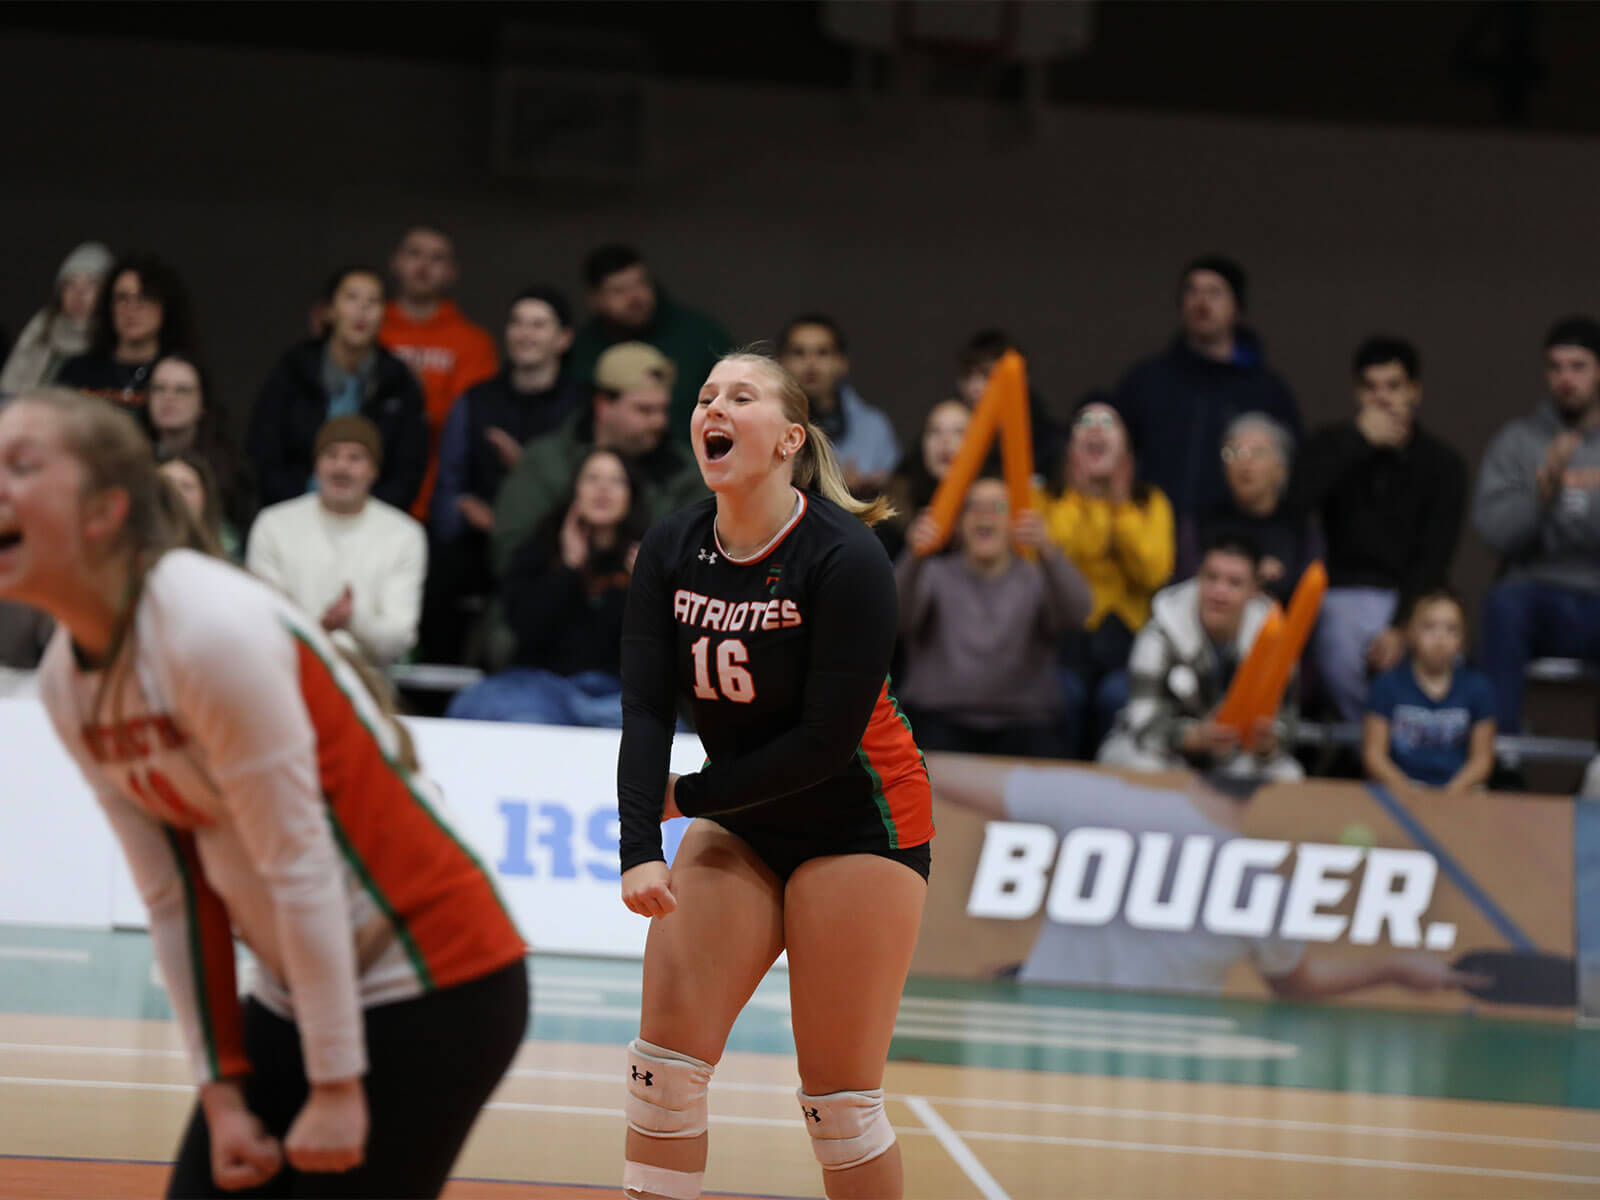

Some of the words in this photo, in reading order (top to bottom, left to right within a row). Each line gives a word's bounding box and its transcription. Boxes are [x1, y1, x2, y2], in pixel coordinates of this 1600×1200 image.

[673, 588, 803, 632] ATRIOTES
[691, 635, 756, 704] 16
[967, 820, 1458, 950] BOUGER.
